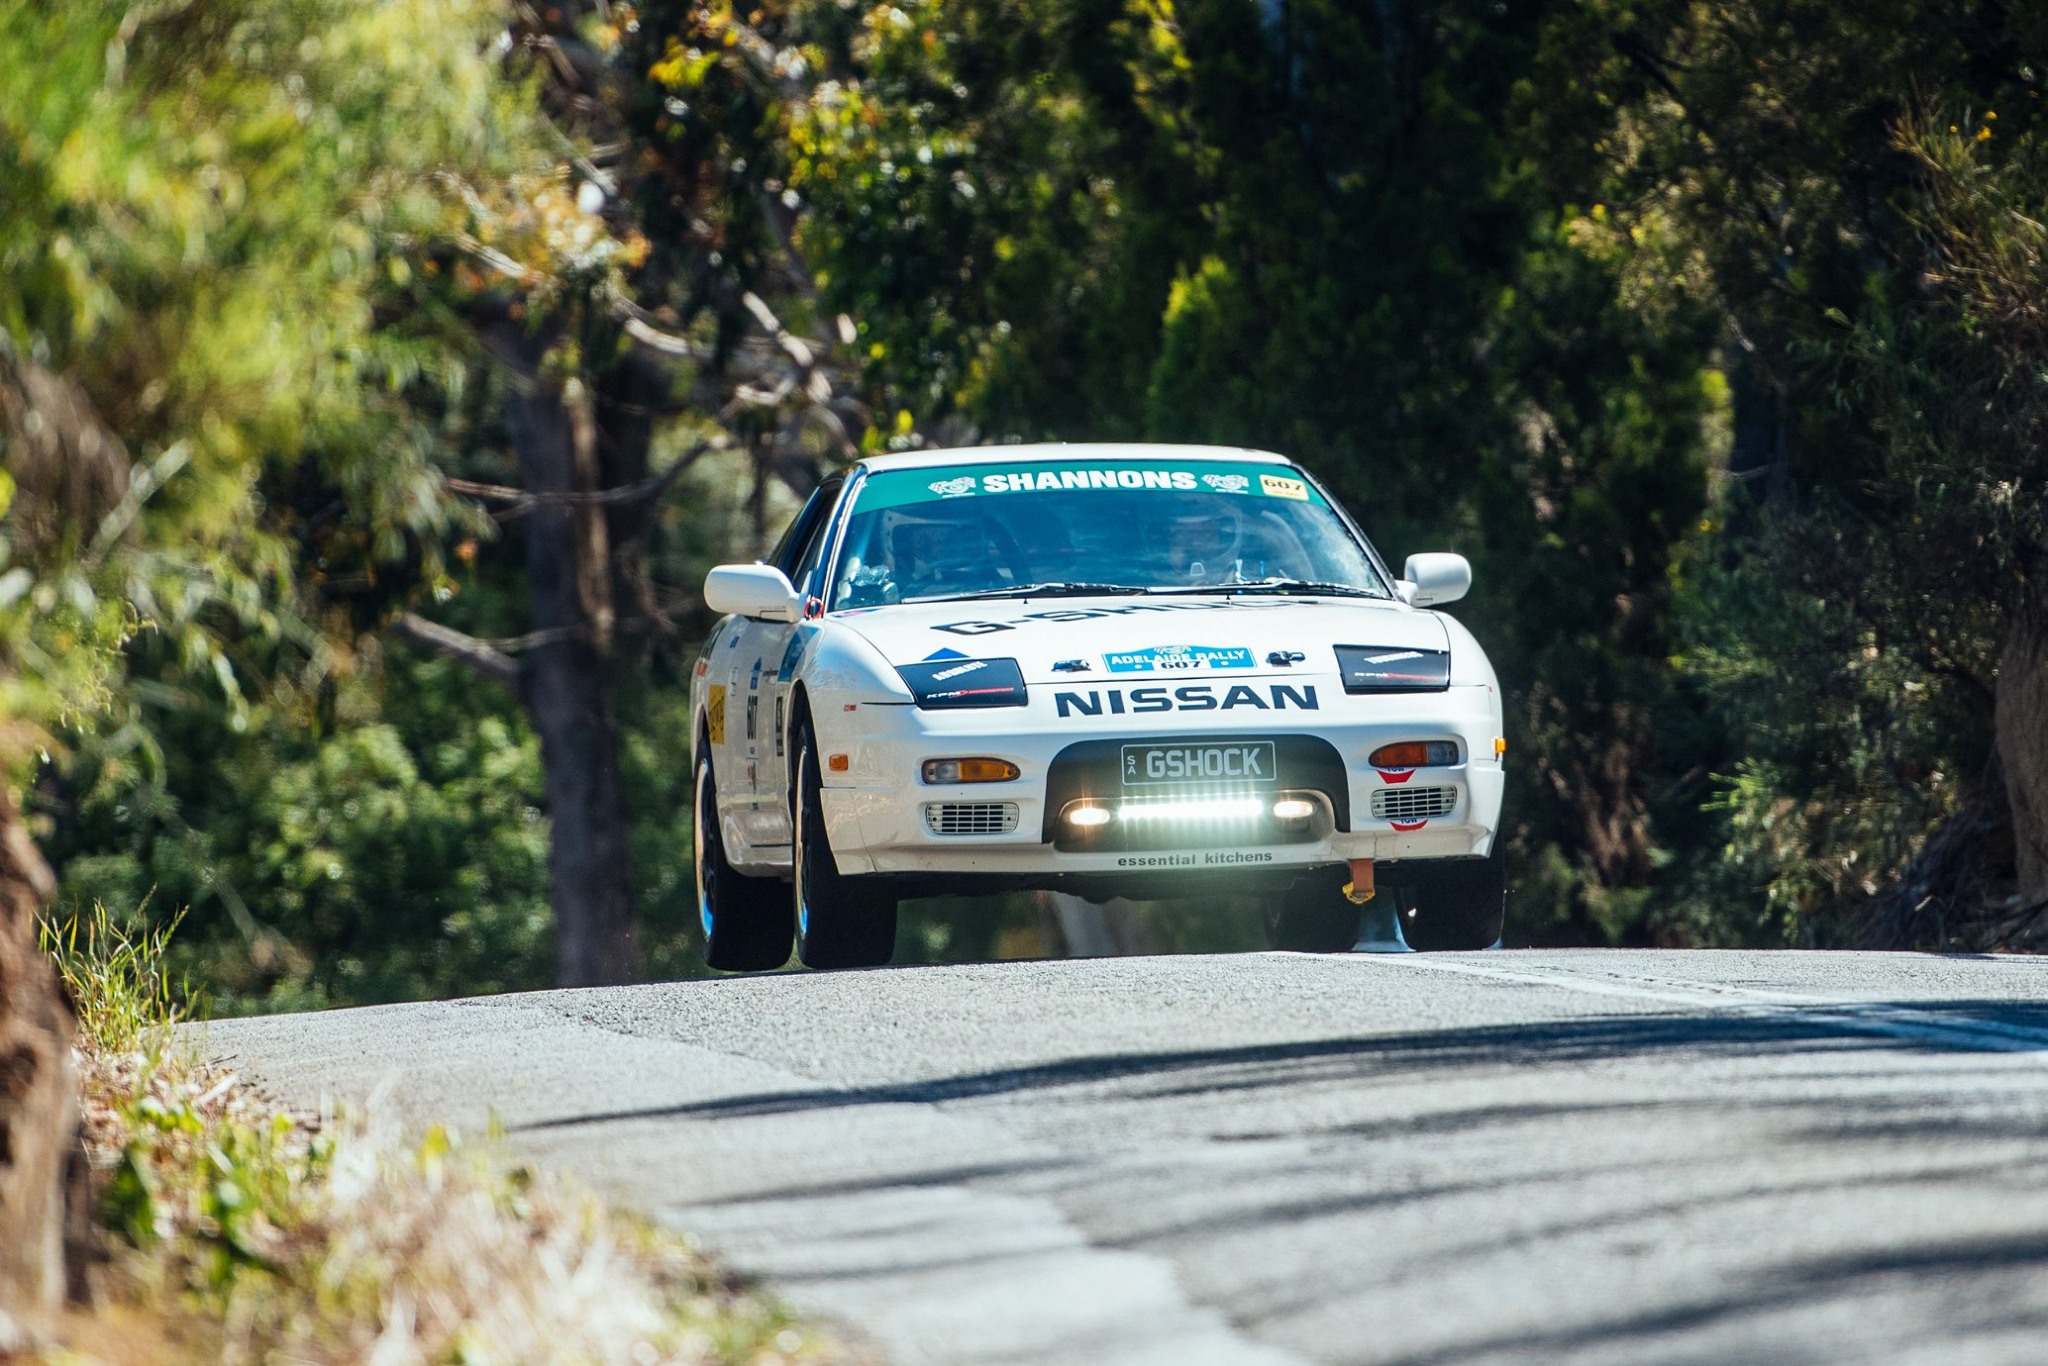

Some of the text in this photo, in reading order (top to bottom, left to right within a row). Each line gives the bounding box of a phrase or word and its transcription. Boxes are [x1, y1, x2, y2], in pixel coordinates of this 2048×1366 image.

[983, 470, 1198, 492] SHANNONS
[1263, 479, 1302, 491] 607
[1111, 652, 1193, 665] ADELAIDE
[1161, 660, 1201, 669] 607
[926, 691, 961, 699] KPM
[1054, 685, 1319, 718] NISSAN
[1146, 747, 1262, 778] GSHOCK
[1118, 851, 1273, 866] essential kitchens
